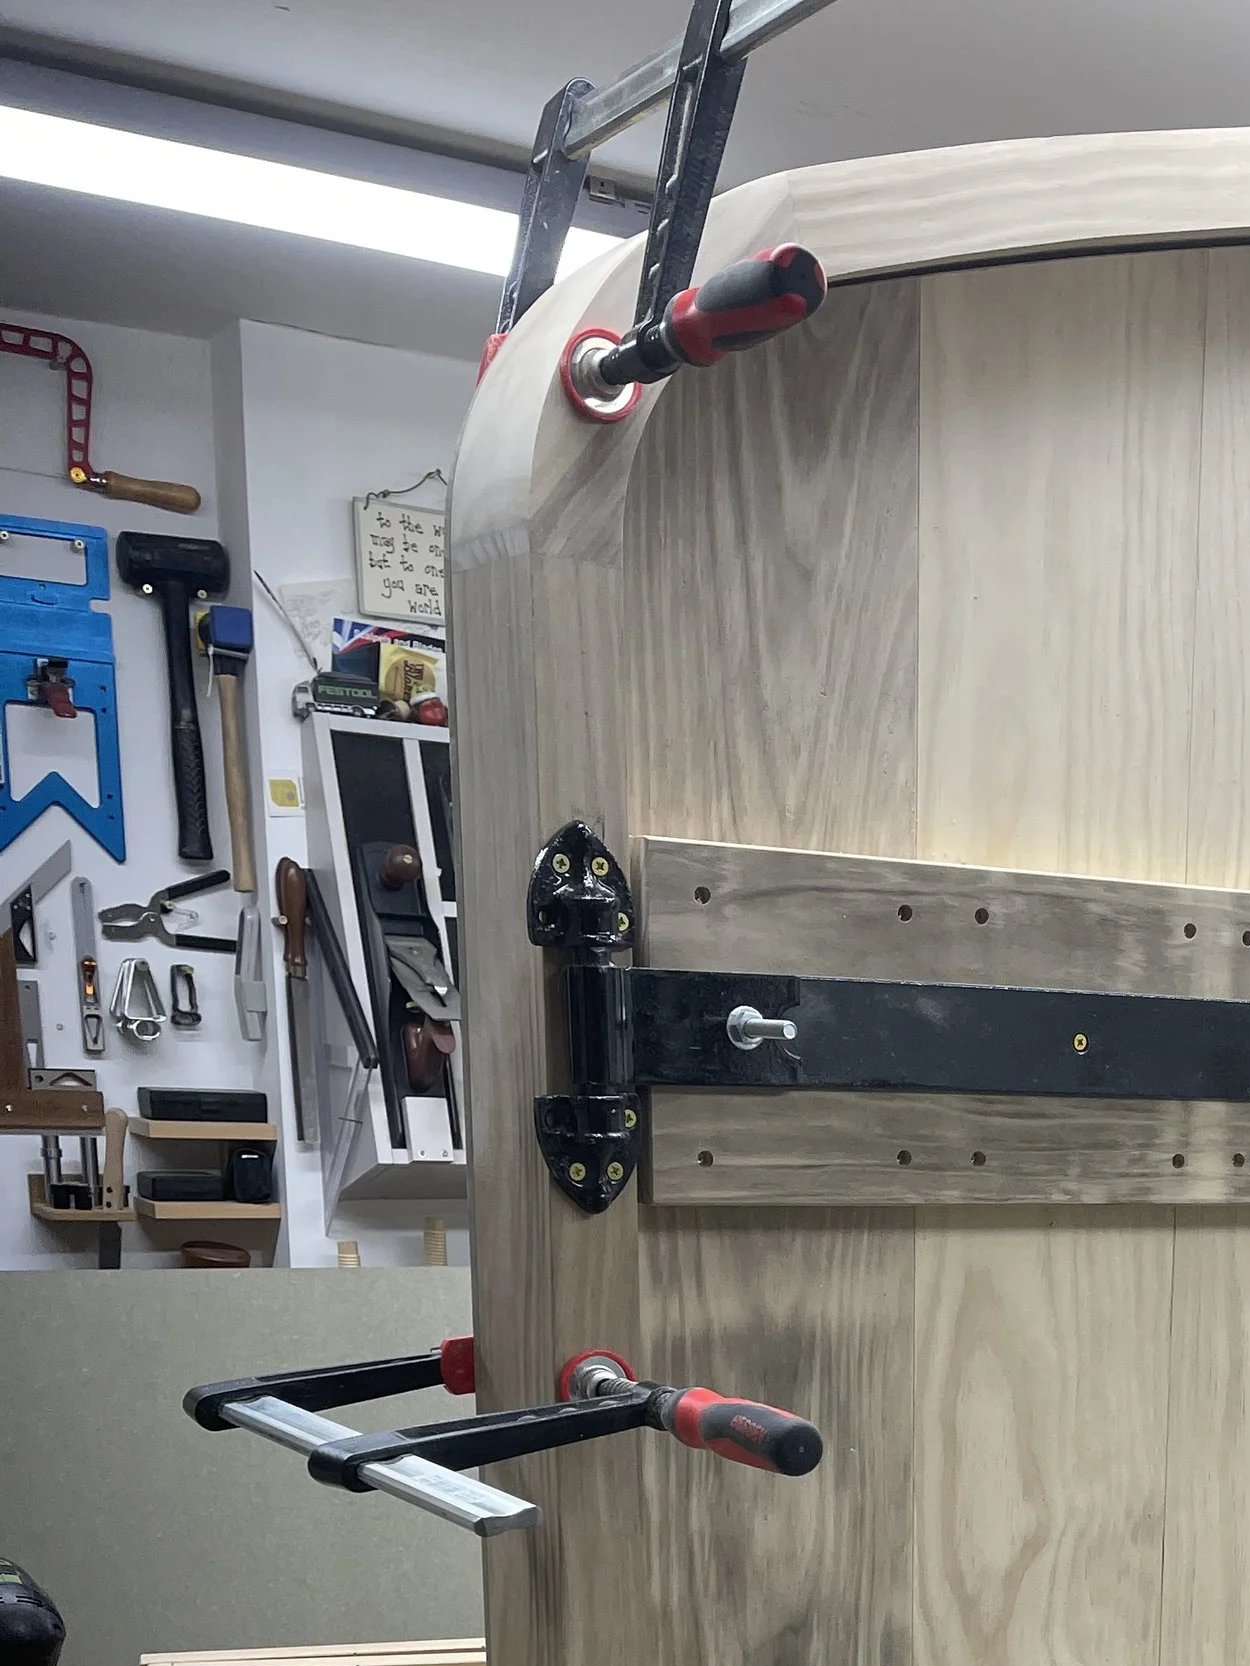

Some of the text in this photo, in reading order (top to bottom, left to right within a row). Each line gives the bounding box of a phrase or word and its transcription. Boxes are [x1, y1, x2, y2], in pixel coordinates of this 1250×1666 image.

[376, 511, 391, 528] to
[399, 513, 424, 534] the
[370, 533, 444, 557] may be on
[368, 551, 391, 569] but
[399, 554, 414, 572] to
[381, 578, 439, 598] you are
[317, 685, 377, 699] FESTOOL
